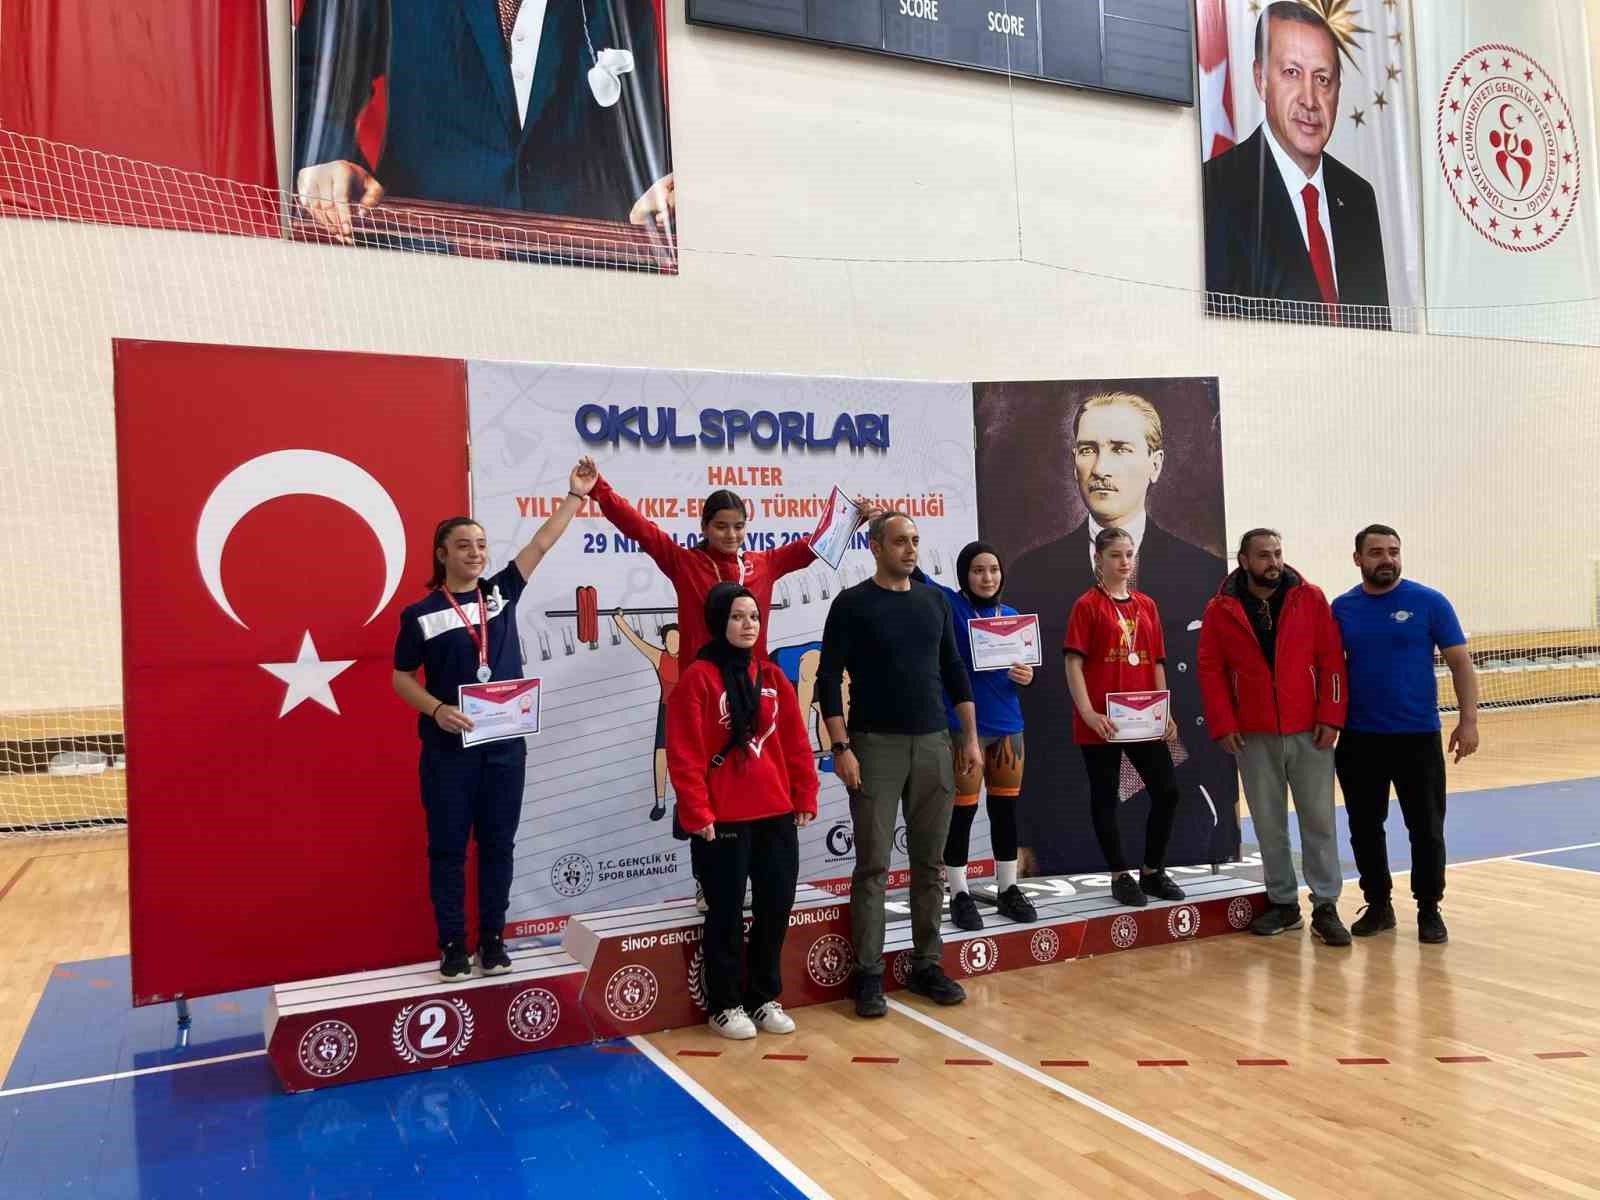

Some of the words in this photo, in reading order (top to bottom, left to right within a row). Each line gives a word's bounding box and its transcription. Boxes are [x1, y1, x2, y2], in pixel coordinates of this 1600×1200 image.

[899, 0, 938, 21] SCORE
[988, 11, 1025, 37] SCORE
[1495, 81, 1534, 107] GENÇLİK
[1464, 84, 1495, 163] CUMHURİYETİ
[1534, 103, 1545, 119] VE
[1543, 121, 1556, 157] SPOR
[1472, 164, 1504, 209] TÜRKİYE
[1527, 157, 1556, 212] BAKANLIĞI
[574, 404, 697, 447] OKUL
[698, 408, 891, 452] SPORLARI
[707, 466, 784, 487] HALTER
[761, 492, 828, 518] TÜRKİY
[583, 533, 608, 554] 29
[598, 860, 616, 870] T.C.
[618, 853, 662, 869] GENÇLİK
[664, 852, 678, 862] VE
[598, 871, 624, 882] SPOR
[625, 863, 678, 879] BAKANLIĞI
[621, 936, 658, 952] SİNOP
[788, 907, 840, 928] DÜRLÜĞÜ
[1178, 909, 1191, 933] 3
[970, 942, 987, 969] 3
[419, 1006, 448, 1049] 2
